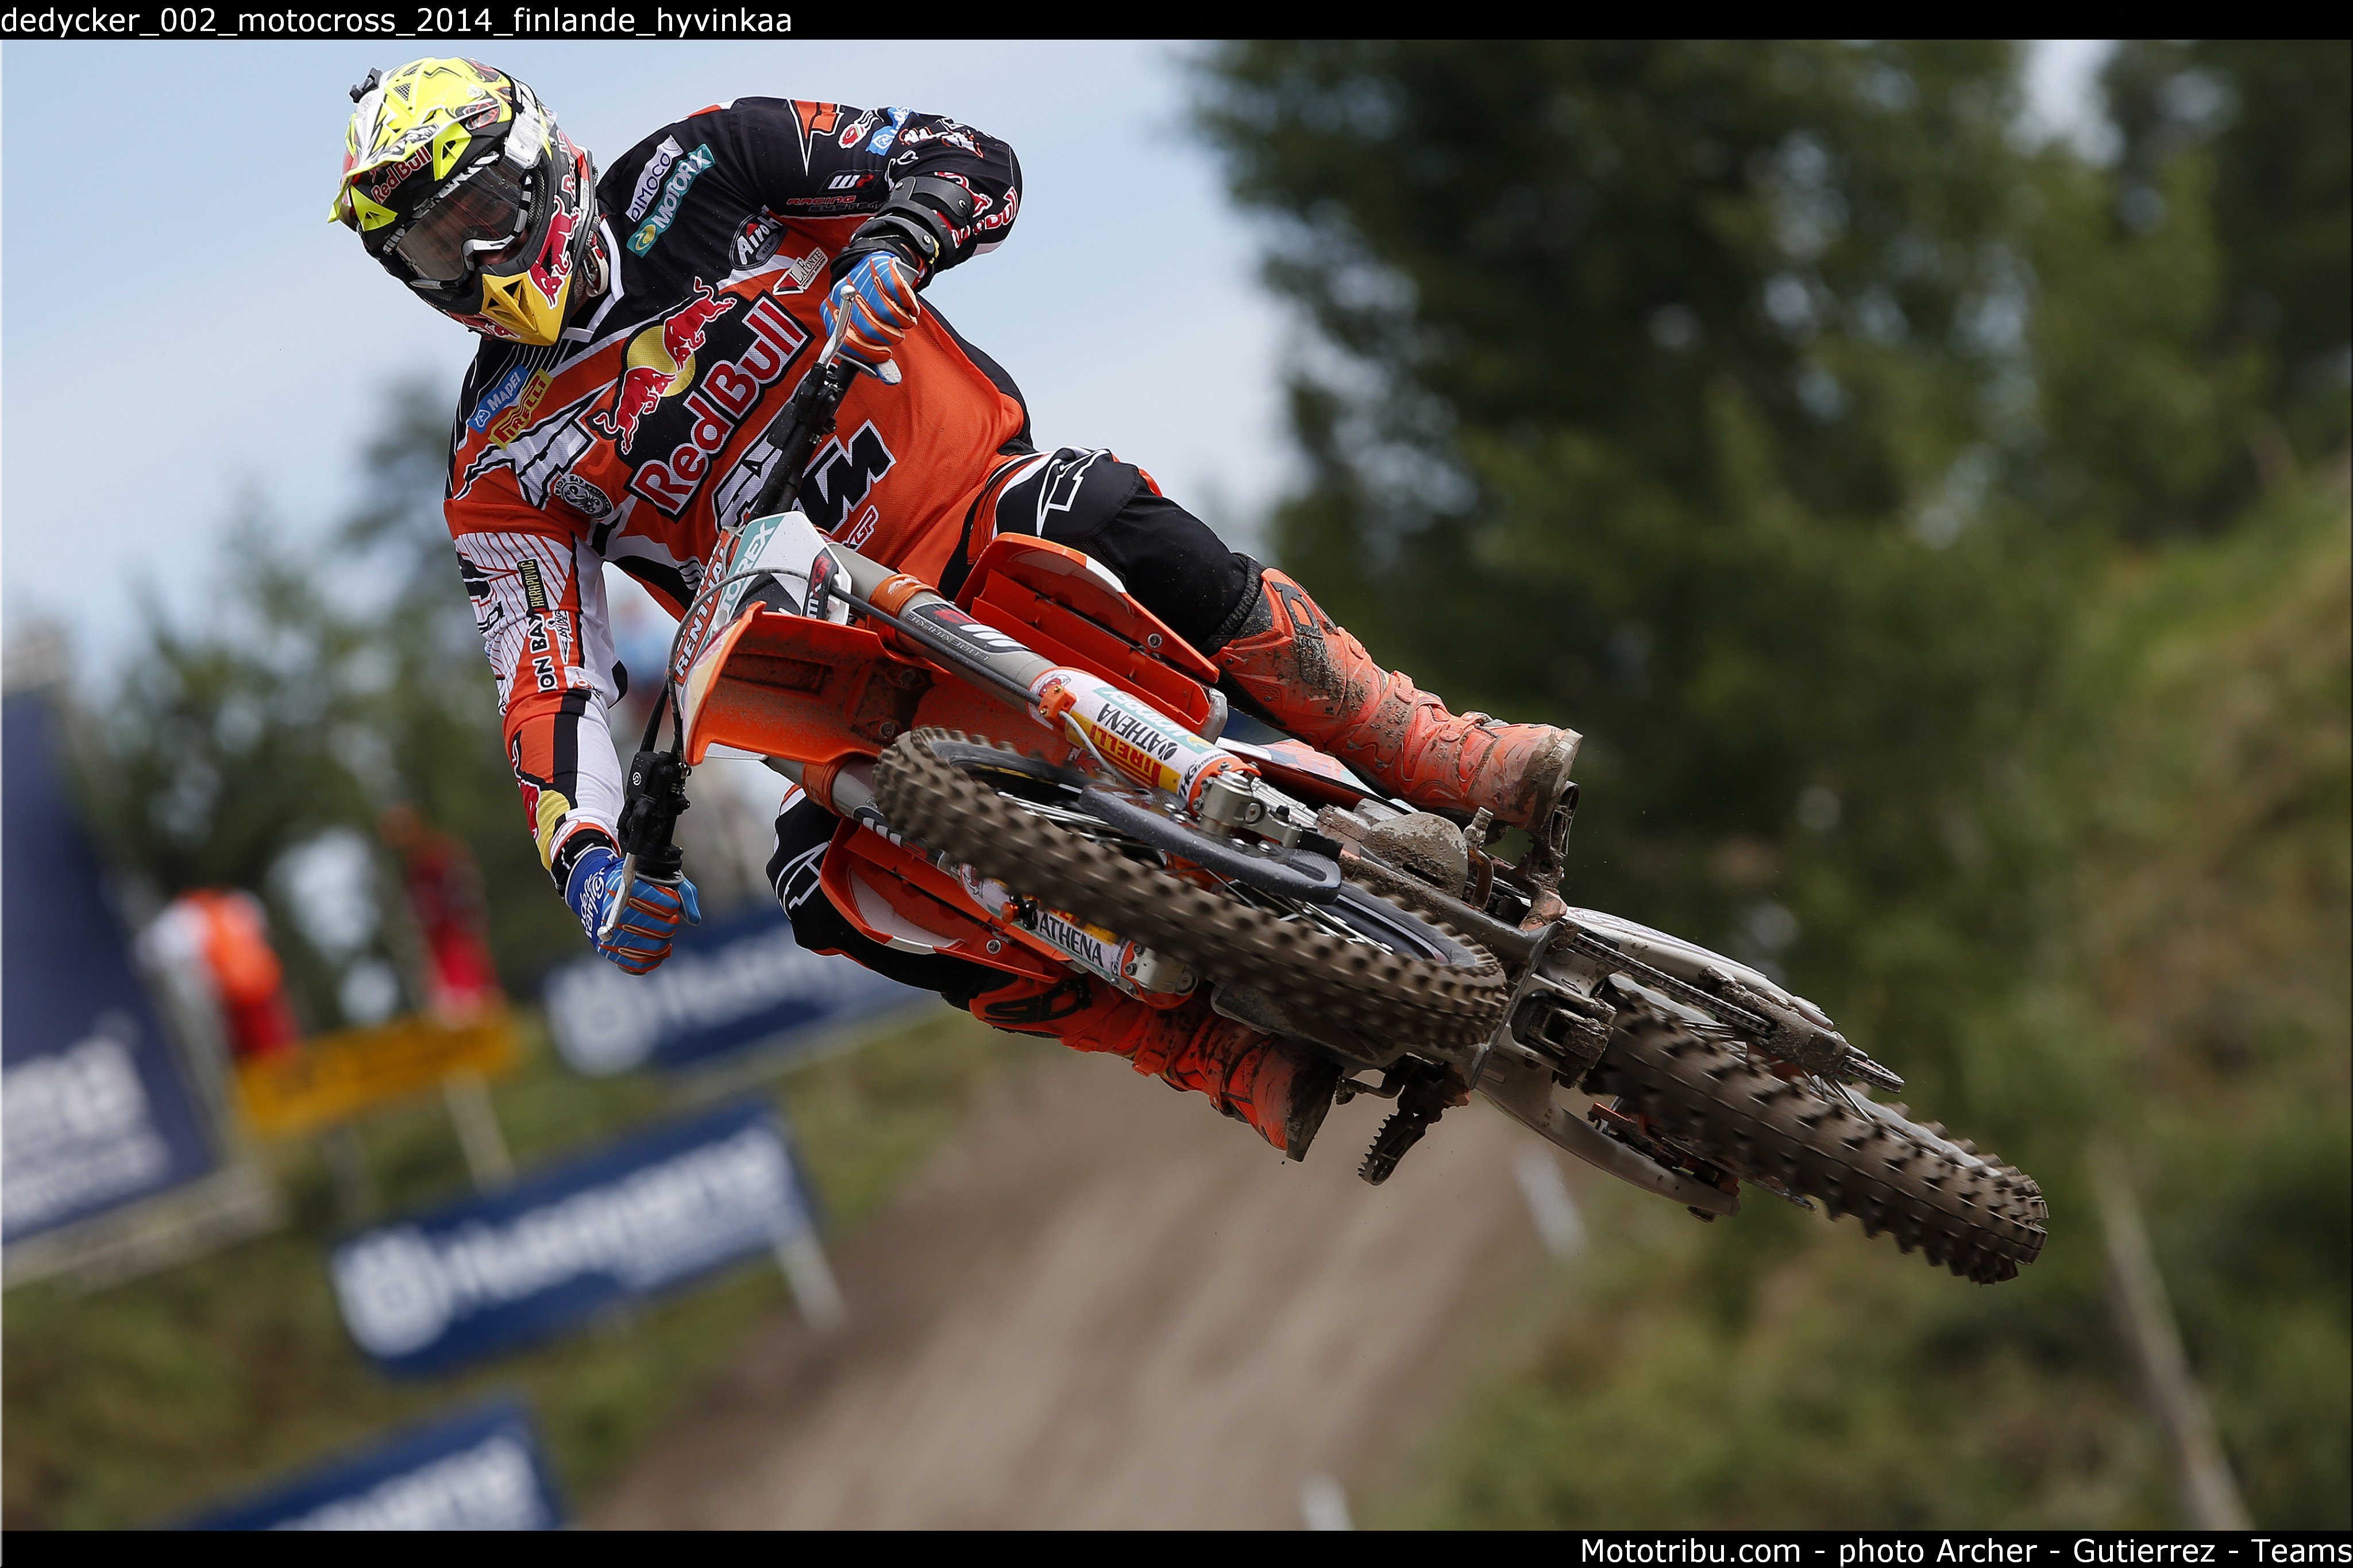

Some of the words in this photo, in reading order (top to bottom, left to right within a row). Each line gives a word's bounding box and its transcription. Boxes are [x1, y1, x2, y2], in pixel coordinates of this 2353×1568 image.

[371, 167, 400, 204] Red
[392, 145, 432, 180] Bull
[631, 152, 670, 221] DIMOCO
[786, 195, 857, 206] RACING
[486, 371, 522, 412] MAPEI
[493, 374, 546, 443] PIRELLI
[630, 390, 735, 515] Red
[700, 296, 808, 419] Bull
[529, 614, 547, 652] BAY
[905, 613, 950, 642] VALVE
[950, 639, 990, 662] CONE
[1097, 703, 1159, 754] ATHENA
[1089, 724, 1162, 787] PIRELLI
[1040, 913, 1104, 968] ATHENA
